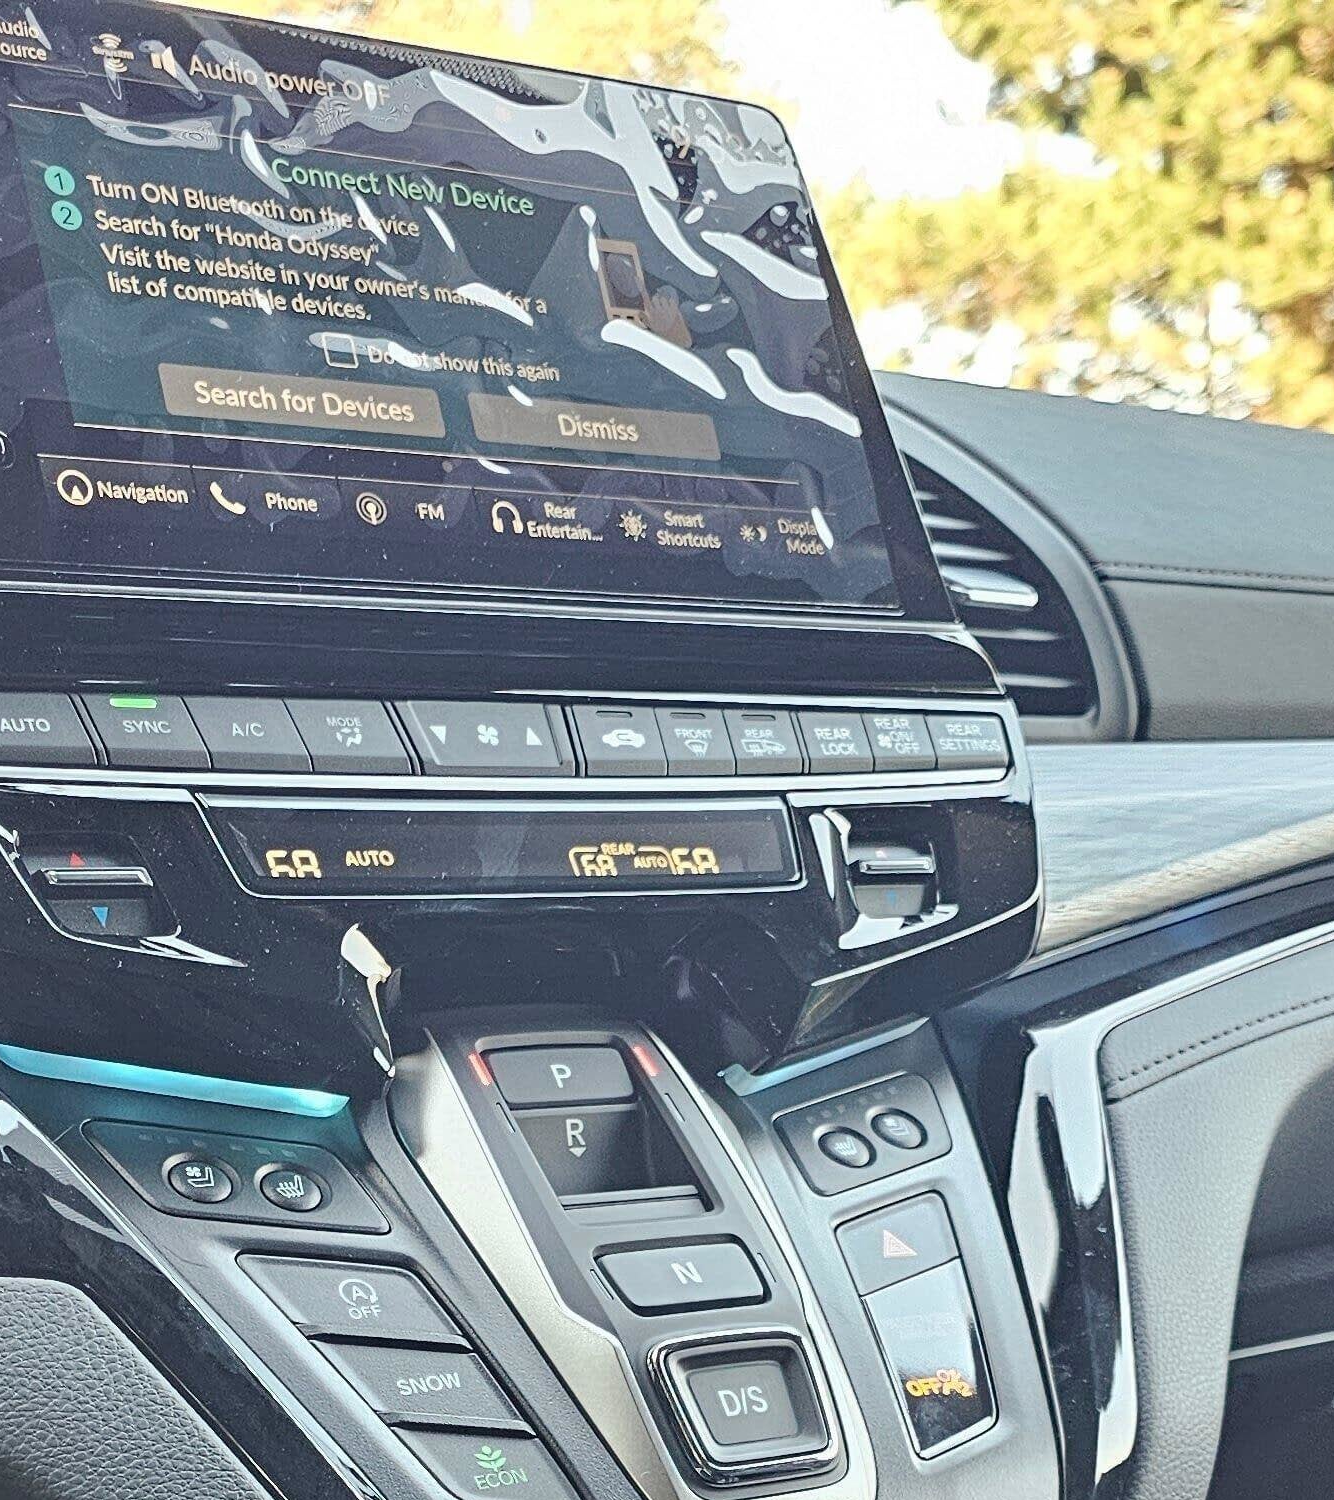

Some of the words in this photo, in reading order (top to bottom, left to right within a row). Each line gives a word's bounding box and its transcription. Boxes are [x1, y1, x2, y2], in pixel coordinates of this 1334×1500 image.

[189, 54, 258, 86] Audio
[264, 71, 336, 96] power
[342, 79, 391, 106] OF
[271, 158, 382, 196] Connect
[387, 174, 444, 204] New
[450, 182, 535, 216] Device
[85, 174, 137, 201] Turn
[141, 182, 179, 207] ON
[183, 187, 285, 222] Bluetooth
[289, 207, 318, 224] on
[319, 206, 353, 228] the
[357, 212, 420, 237] dvice
[94, 209, 167, 238] Search
[170, 219, 201, 242] for
[205, 223, 283, 252] "Honda
[287, 235, 379, 267] Odyssey"
[99, 242, 152, 269] Visit
[155, 249, 191, 273] the
[195, 257, 276, 284] website
[279, 264, 301, 287] in
[303, 271, 350, 292] your
[354, 276, 430, 301] owner's
[535, 299, 548, 315] a
[107, 271, 142, 296] list
[145, 278, 168, 298] of
[173, 283, 287, 312] compatible
[291, 293, 372, 321] devices.
[367, 345, 395, 365] Do
[434, 352, 479, 374] show
[482, 356, 514, 377] this
[516, 362, 560, 383] again
[193, 380, 277, 412] Search
[281, 388, 317, 414] for
[321, 392, 415, 423] Devices
[556, 413, 639, 443] Dismiss
[96, 480, 190, 505] Navigation
[265, 491, 319, 514] Phone
[418, 503, 445, 521] FM
[544, 501, 578, 521] Rear
[664, 510, 705, 529] Smart
[526, 519, 604, 542] Entertain...
[777, 518, 822, 538] Displa
[656, 530, 722, 550] Shortcuts
[785, 537, 825, 556] Mode
[0, 717, 52, 734] AUTO
[123, 719, 173, 735] SYNC
[231, 721, 266, 738] A/C
[326, 716, 363, 728] MODE
[873, 717, 912, 731] REAR
[945, 723, 983, 737] REAR
[673, 728, 713, 740] FRONT
[743, 729, 774, 740] REAR
[813, 727, 852, 741] REAR
[820, 743, 859, 757] LOCK
[895, 742, 922, 755] OFF
[938, 738, 1001, 754] SETTINGS
[345, 850, 396, 867] AUTO
[600, 842, 636, 856] REAR
[633, 855, 668, 869] AUTO
[550, 1063, 572, 1089] P
[564, 1118, 585, 1147] R
[677, 1261, 703, 1285] N
[351, 1284, 369, 1301] A
[348, 1304, 382, 1320] OFF
[396, 1372, 461, 1396] SNOW
[718, 1383, 769, 1418] D/S
[474, 1468, 529, 1490] ECON
